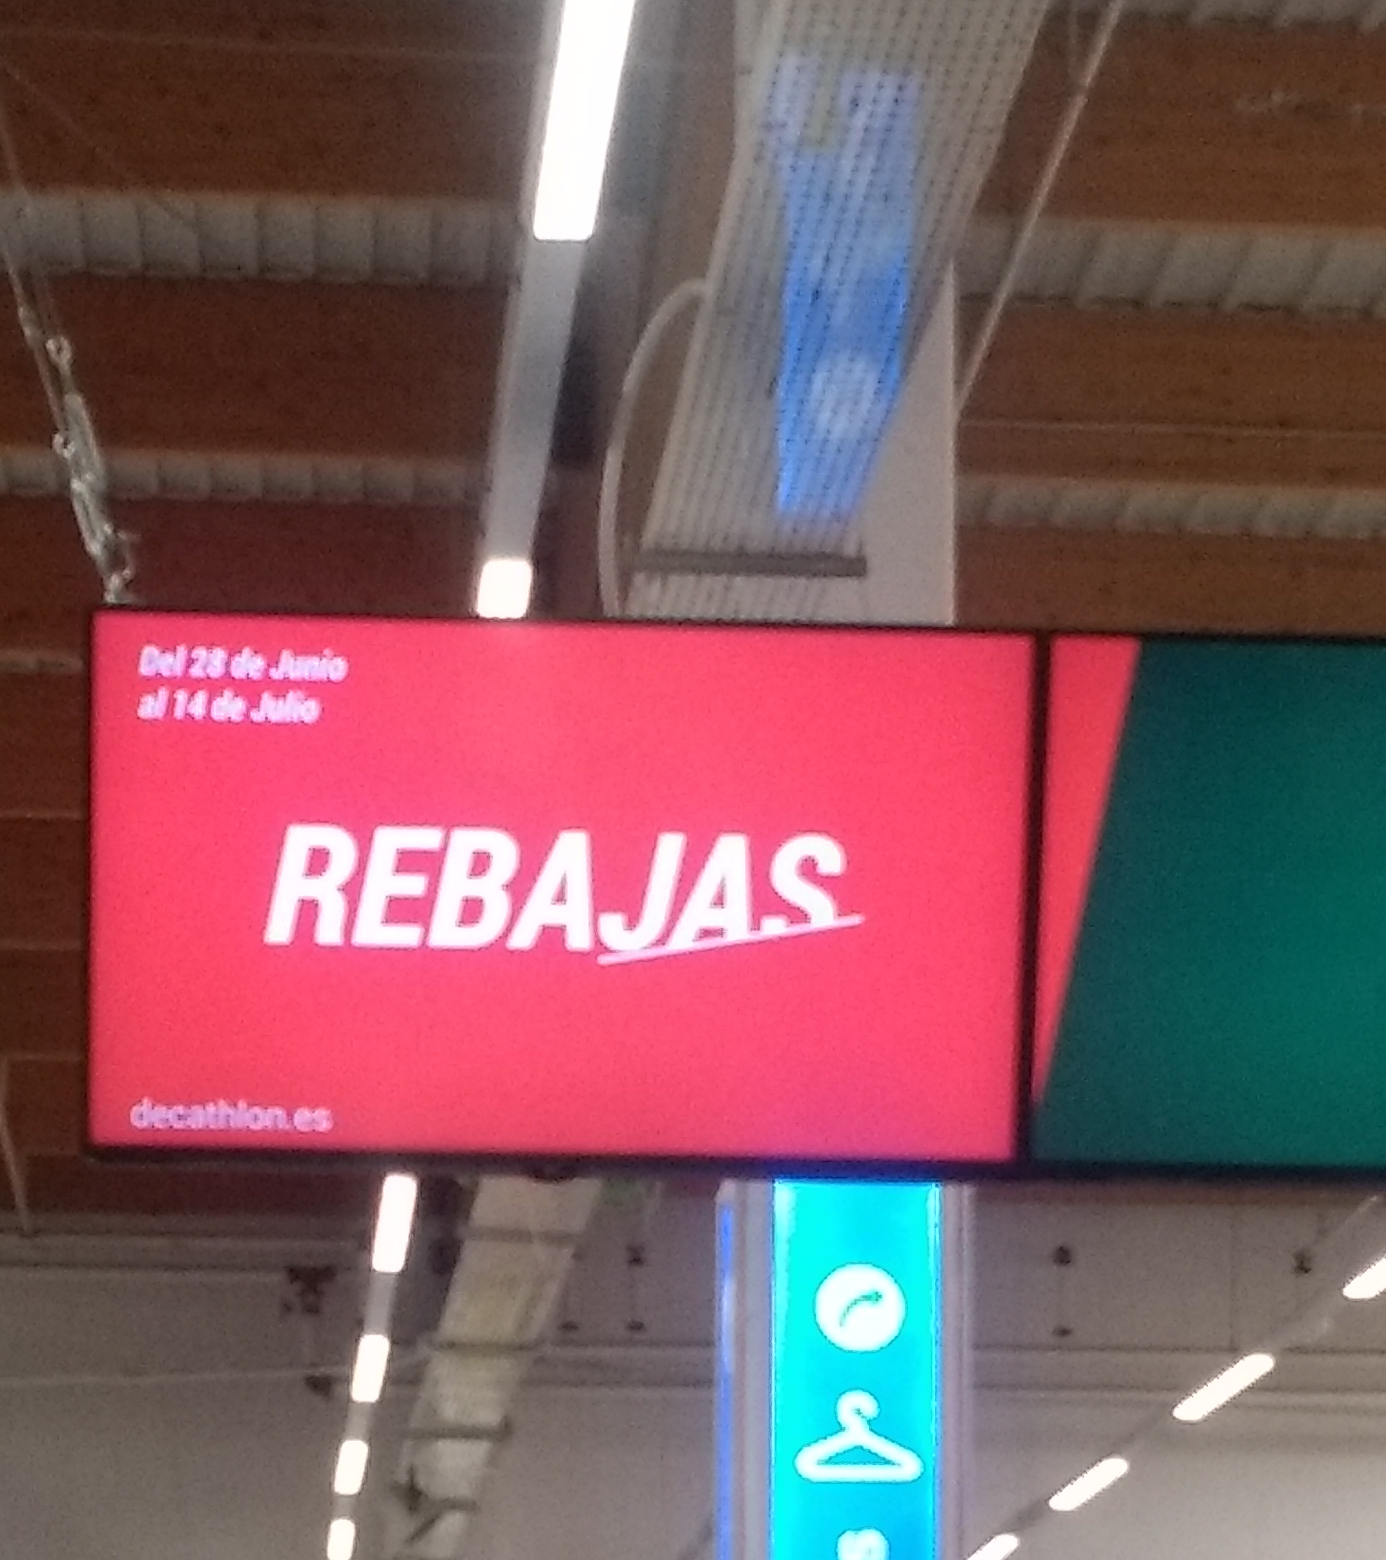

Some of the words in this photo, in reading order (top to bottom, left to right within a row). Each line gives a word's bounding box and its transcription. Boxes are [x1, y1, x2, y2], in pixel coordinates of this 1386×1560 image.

[139, 644, 187, 678] Del
[188, 646, 228, 680] 28
[230, 646, 266, 680] de
[268, 648, 350, 682] Junio
[137, 685, 168, 721] al
[172, 688, 209, 721] 14
[210, 687, 247, 723] de
[249, 689, 322, 724] Julio
[263, 822, 861, 962] REBAJAS
[129, 1096, 334, 1134] decathlon.es
